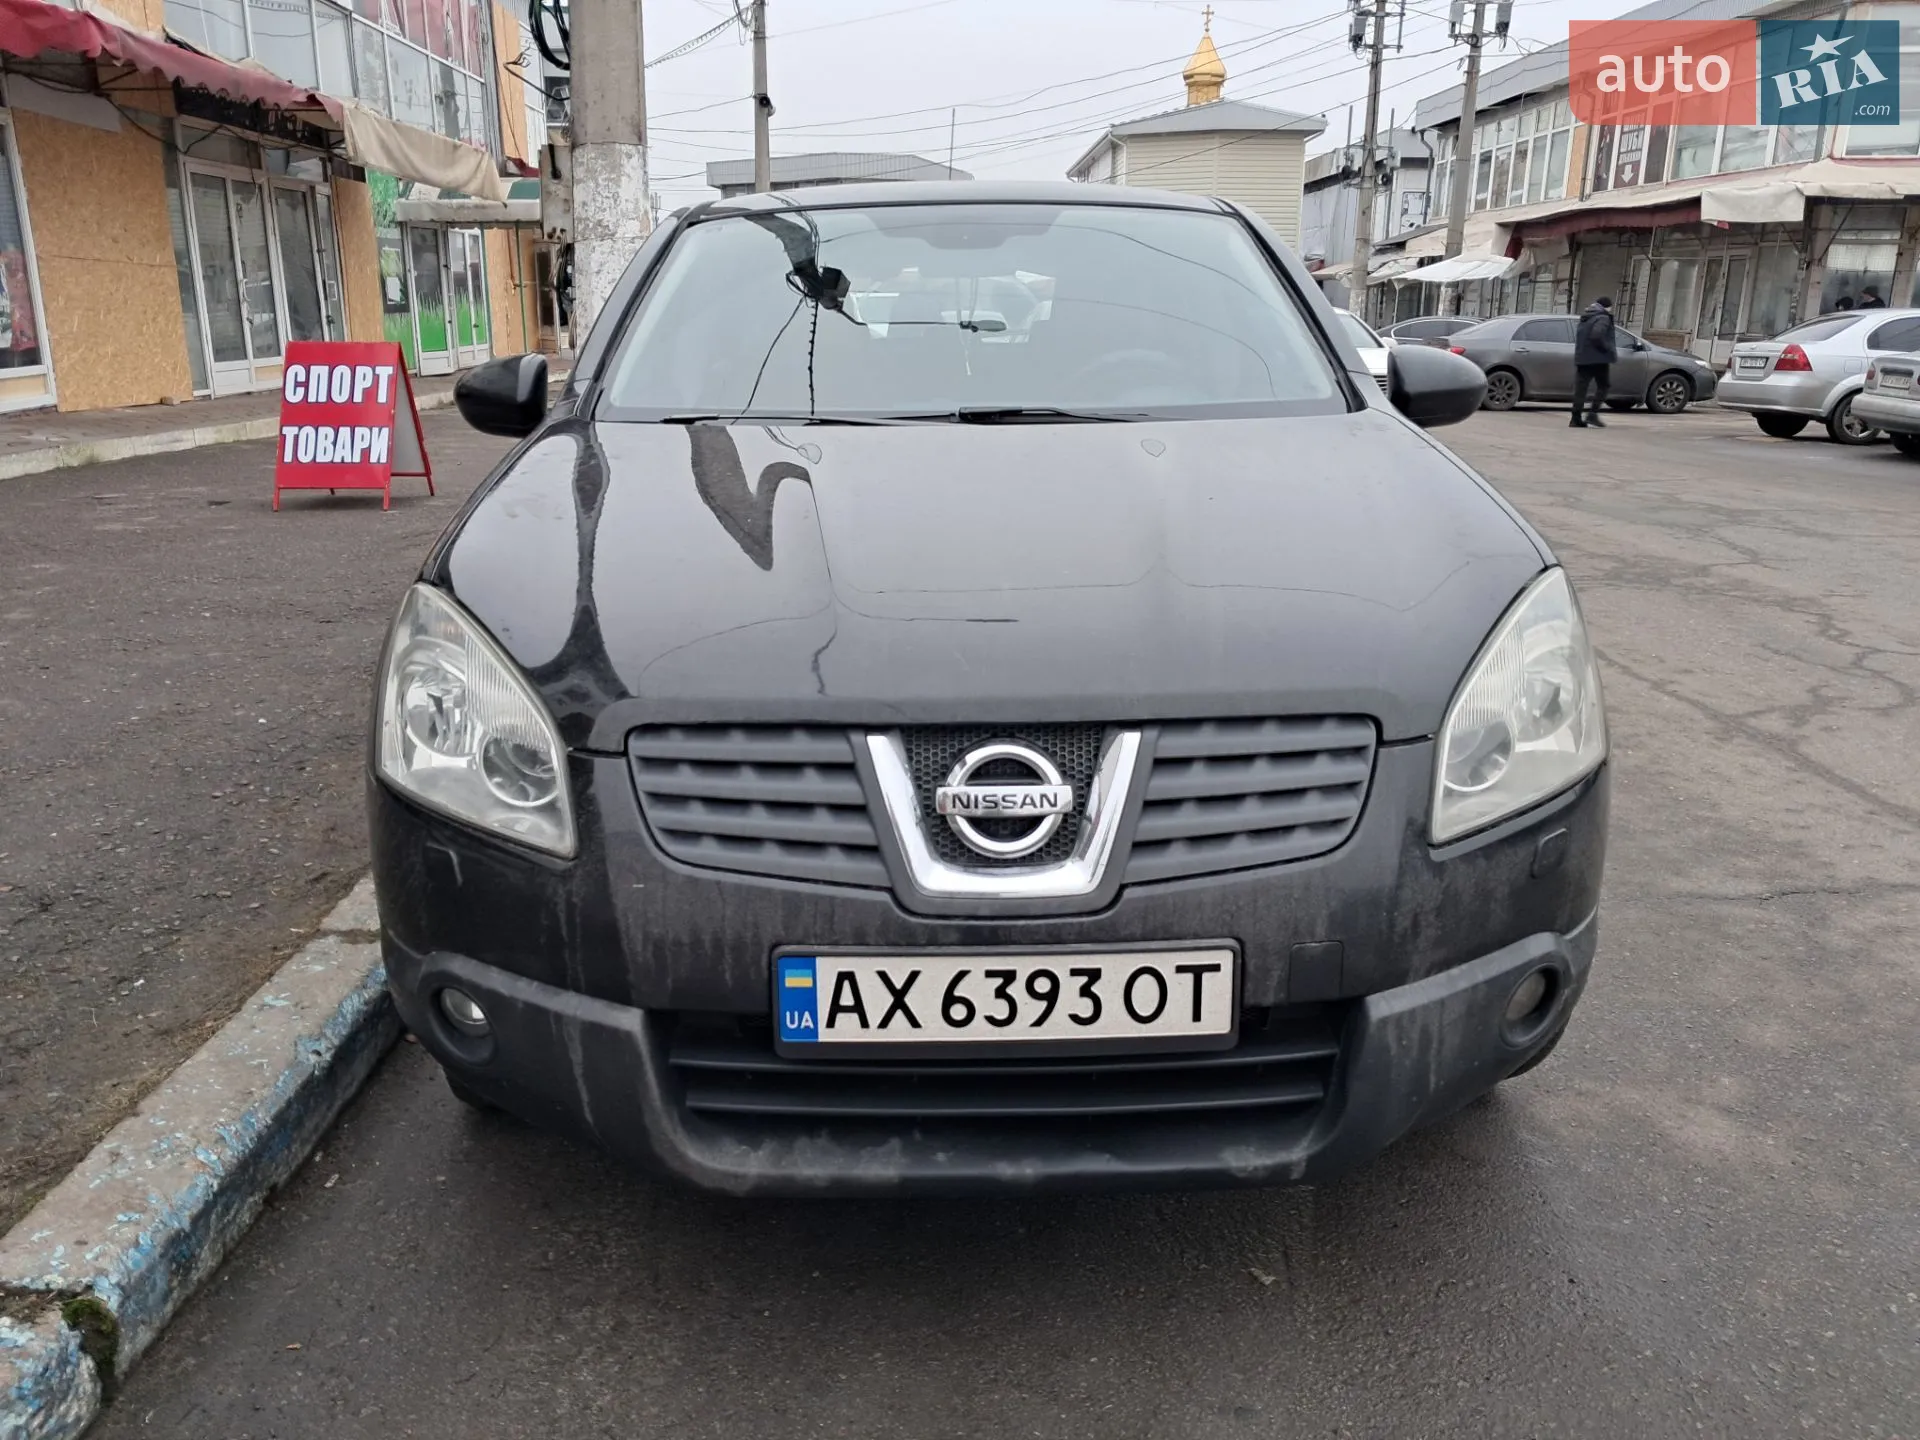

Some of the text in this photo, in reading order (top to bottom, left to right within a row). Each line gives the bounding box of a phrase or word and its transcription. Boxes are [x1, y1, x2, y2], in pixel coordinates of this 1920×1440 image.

[284, 364, 394, 404] СПОРТ
[281, 425, 390, 464] ТОВАРИ
[951, 792, 1058, 810] NISSAN
[824, 964, 1222, 1029] AX 6393 OT
[785, 1010, 814, 1030] UA
